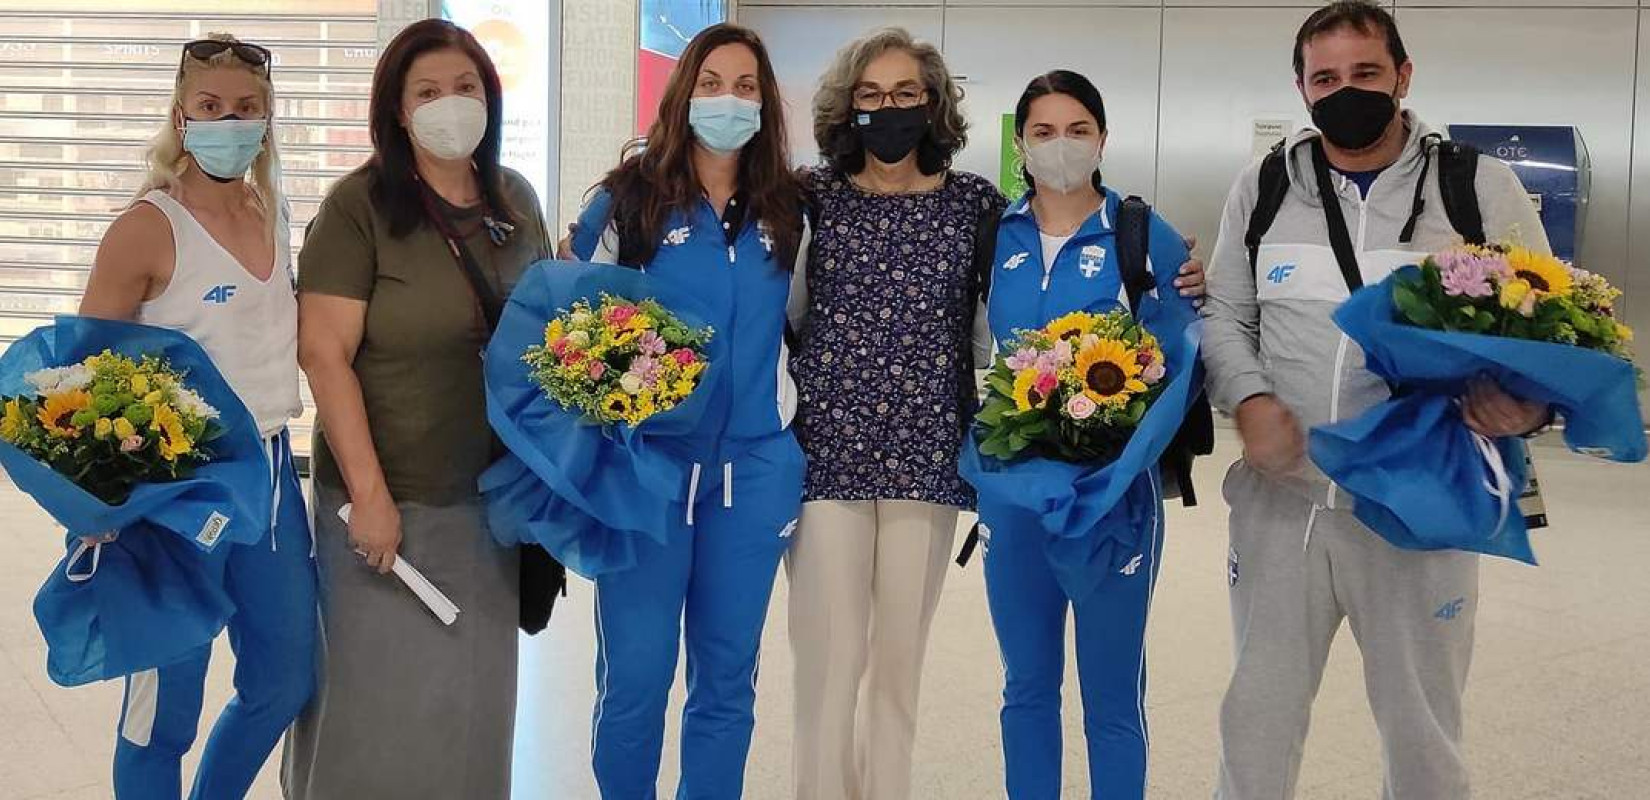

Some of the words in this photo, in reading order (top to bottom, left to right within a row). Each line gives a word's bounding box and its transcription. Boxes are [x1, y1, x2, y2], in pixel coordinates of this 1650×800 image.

[1002, 251, 1031, 270] 4F
[1266, 265, 1296, 284] 4F
[202, 284, 237, 304] 4F
